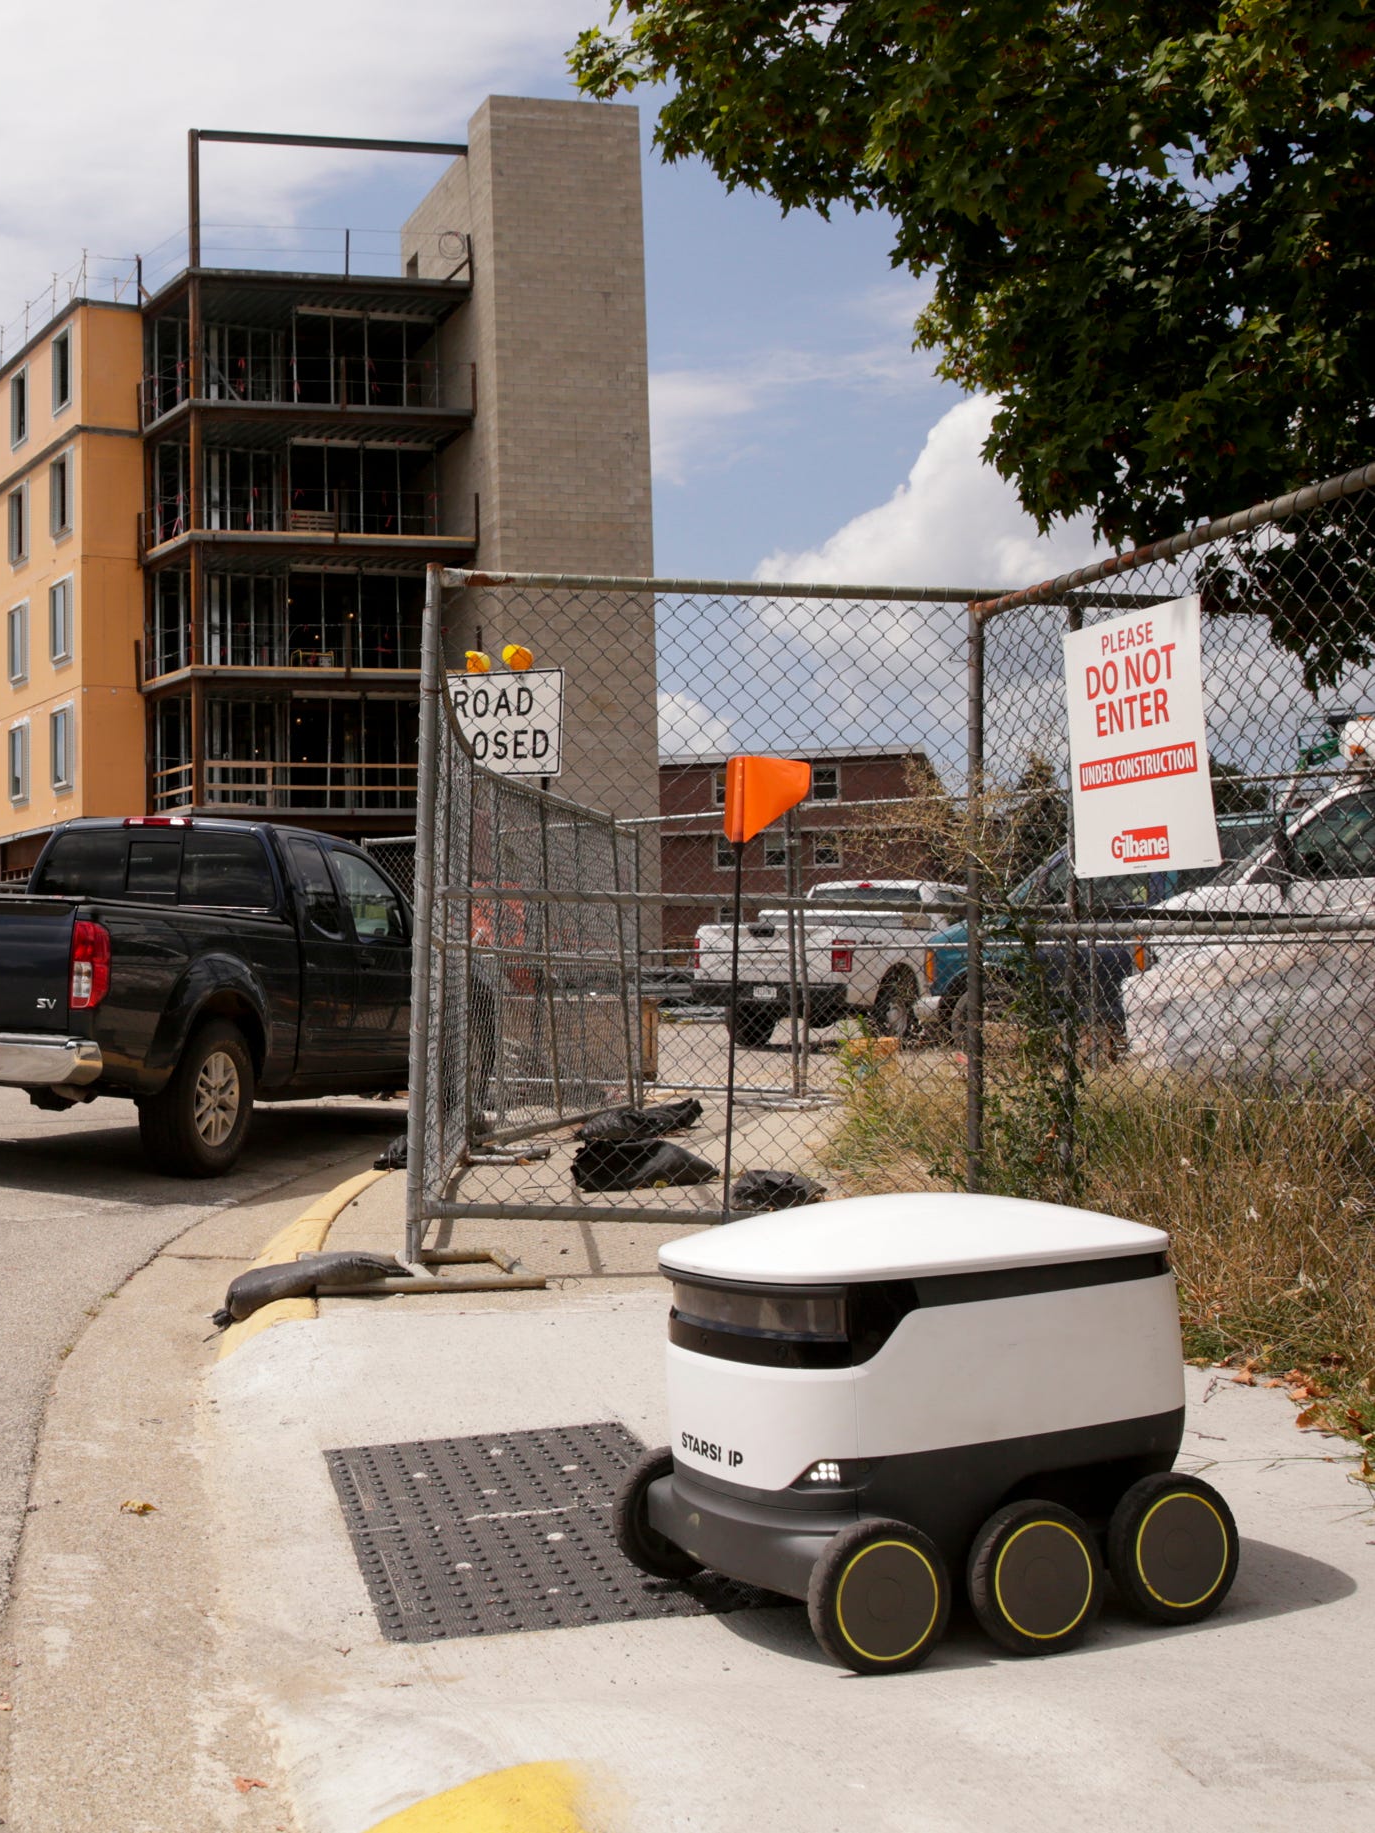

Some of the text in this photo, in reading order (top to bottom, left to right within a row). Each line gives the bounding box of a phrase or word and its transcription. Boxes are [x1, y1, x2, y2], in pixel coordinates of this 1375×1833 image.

[1101, 621, 1154, 656] PLEASE
[1085, 643, 1176, 700] DO NOT
[453, 687, 534, 718] ROAD
[1095, 688, 1170, 737] ENTER
[471, 729, 549, 760] OSED
[1081, 746, 1195, 787] UNDER CONSTRUCTION
[1111, 833, 1169, 860] Gilbane
[36, 997, 57, 1010] SV
